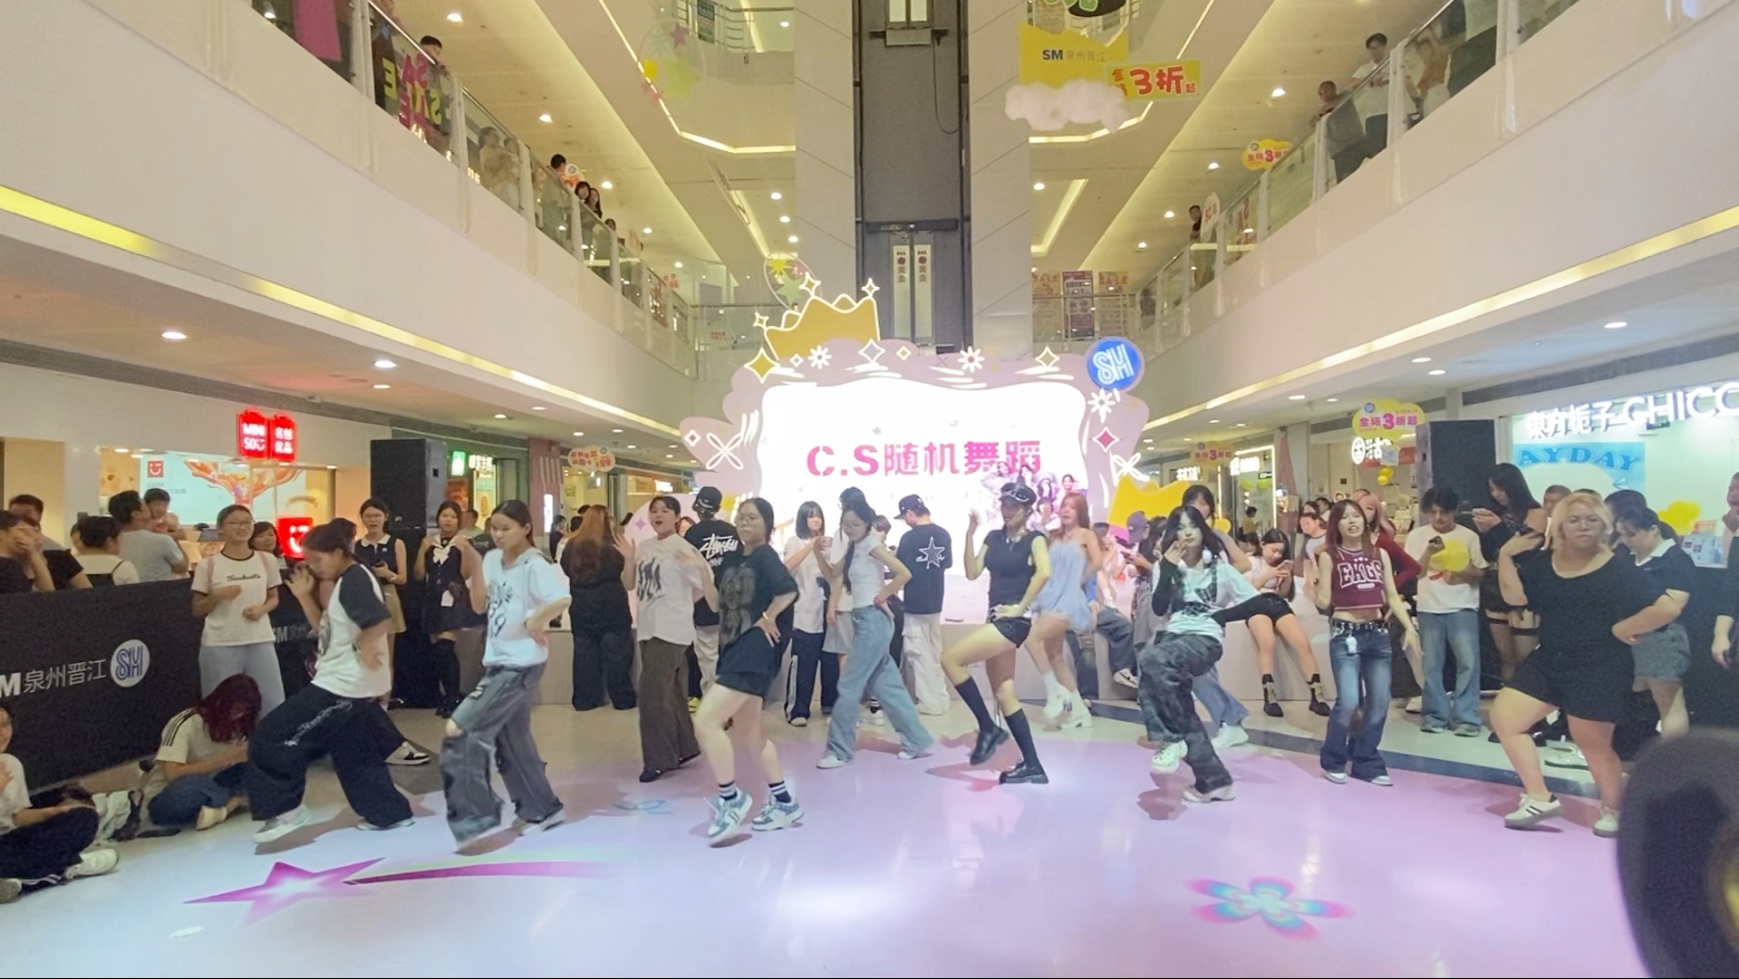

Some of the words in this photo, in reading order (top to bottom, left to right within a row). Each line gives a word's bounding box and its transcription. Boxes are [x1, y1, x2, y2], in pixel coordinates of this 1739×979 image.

[1042, 50, 1064, 60] SM
[243, 423, 265, 437] MINI
[273, 626, 288, 642] M
[23, 659, 107, 694] 泉州晋江
